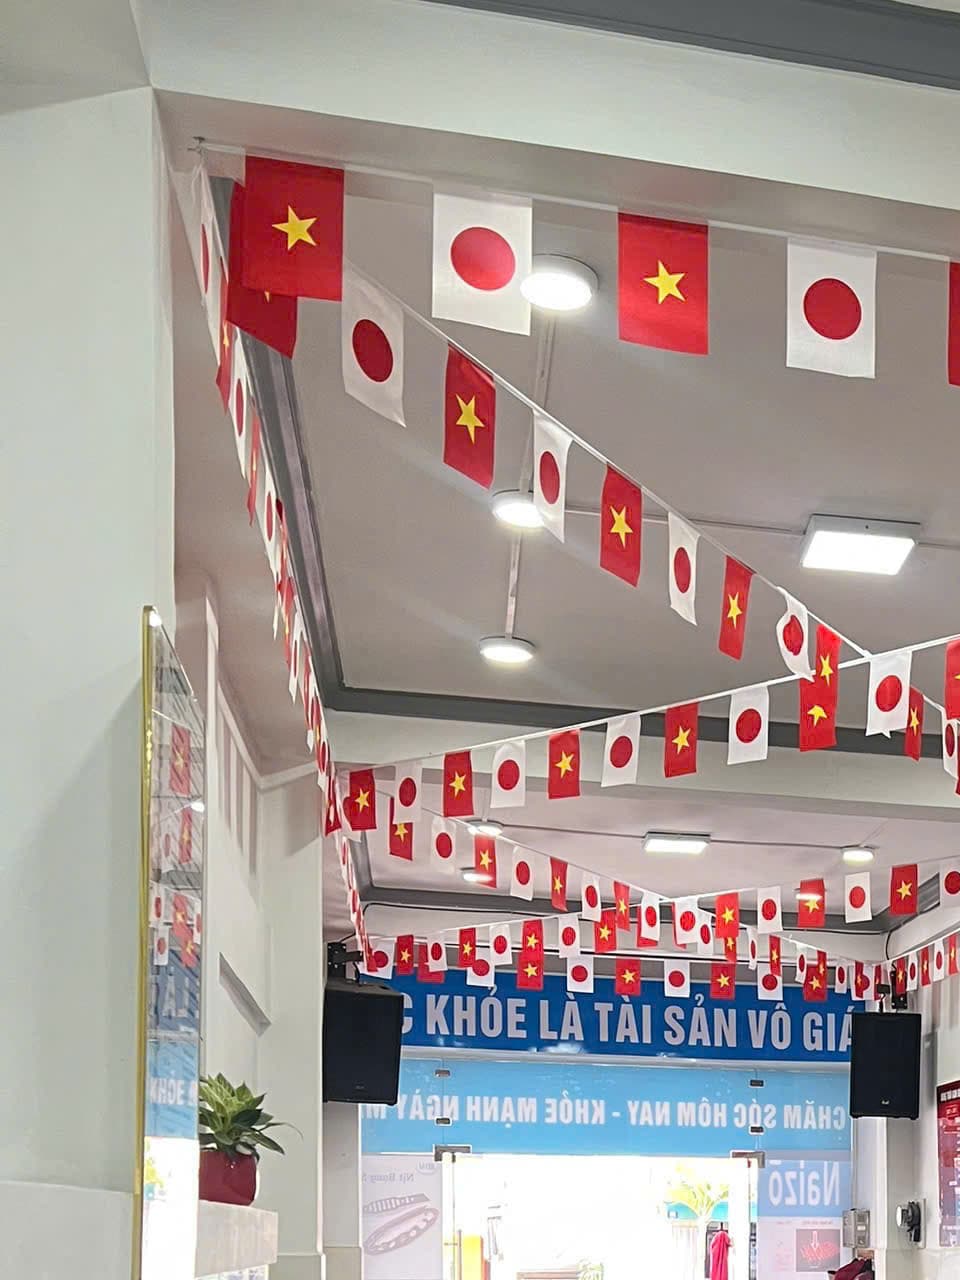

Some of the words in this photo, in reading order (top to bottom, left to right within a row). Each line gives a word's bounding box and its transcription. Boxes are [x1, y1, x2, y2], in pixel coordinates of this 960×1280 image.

[426, 984, 527, 1039] KHỎE
[540, 992, 584, 1041] LÀ
[594, 995, 652, 1044] TÀI
[664, 993, 737, 1048] SẢN
[748, 1002, 792, 1050] VÔ
